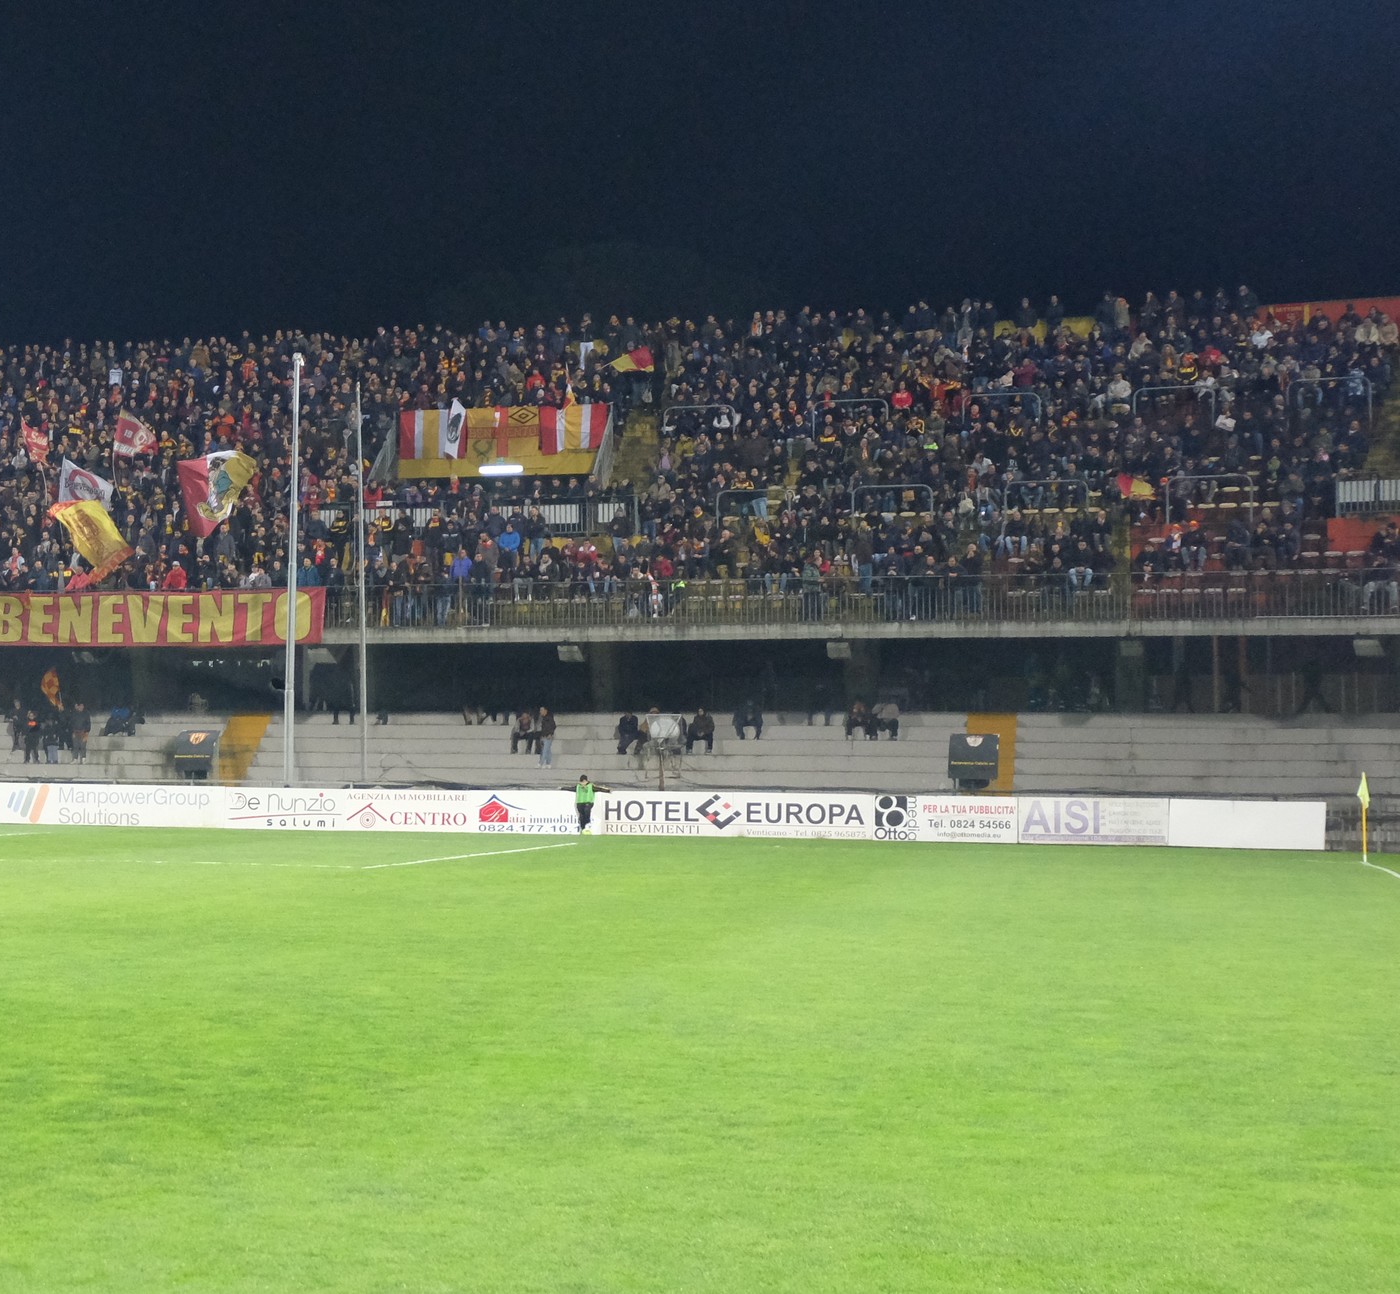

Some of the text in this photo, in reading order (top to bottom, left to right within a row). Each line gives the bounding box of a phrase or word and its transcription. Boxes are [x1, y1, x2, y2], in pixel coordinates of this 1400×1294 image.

[58, 787, 210, 808] ManpowerGroup
[347, 793, 391, 801] AGENZIA
[604, 800, 700, 822] HOTEL
[746, 802, 865, 825] EUROPA
[922, 804, 1016, 815] PER LA TUA PUBBLICITA'
[58, 808, 140, 826] Solutions
[266, 817, 335, 828] salumi
[390, 811, 467, 826] CENTRO
[907, 796, 920, 840] media
[1022, 800, 1100, 834] AISI
[606, 823, 700, 835] RICEVIMENTI
[928, 819, 1012, 830] Tel. 0824 54566
[746, 829, 787, 837] Venticano
[874, 827, 908, 841] Otto
[936, 831, 1001, 839] info@ottomedia.eu
